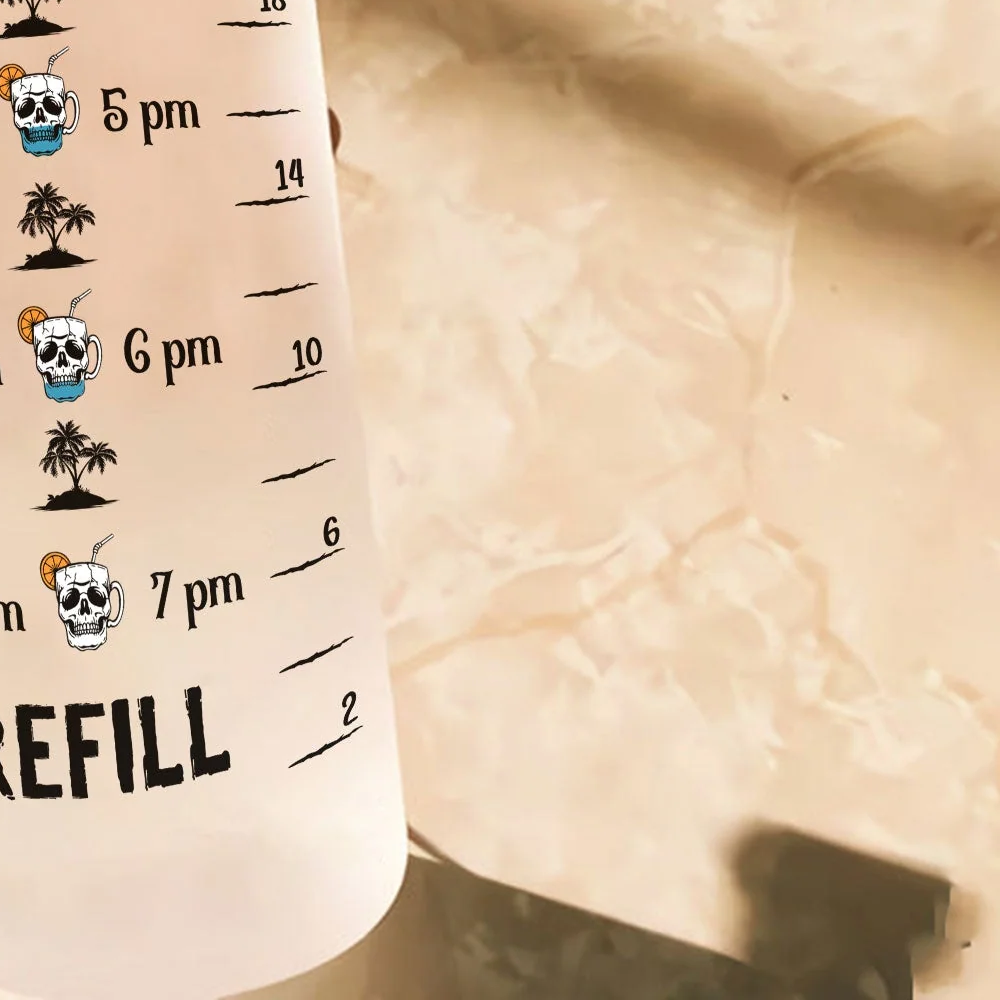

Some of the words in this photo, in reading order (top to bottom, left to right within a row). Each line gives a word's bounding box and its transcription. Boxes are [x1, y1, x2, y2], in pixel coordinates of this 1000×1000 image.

[100, 87, 129, 132] 5
[139, 100, 201, 147] pm
[274, 158, 305, 191] 14
[123, 327, 151, 374] 6
[161, 335, 223, 388] pm
[292, 336, 323, 372] 10
[323, 516, 340, 547] 6
[150, 569, 174, 620] 7
[183, 572, 245, 631] pm
[341, 690, 359, 727] 2
